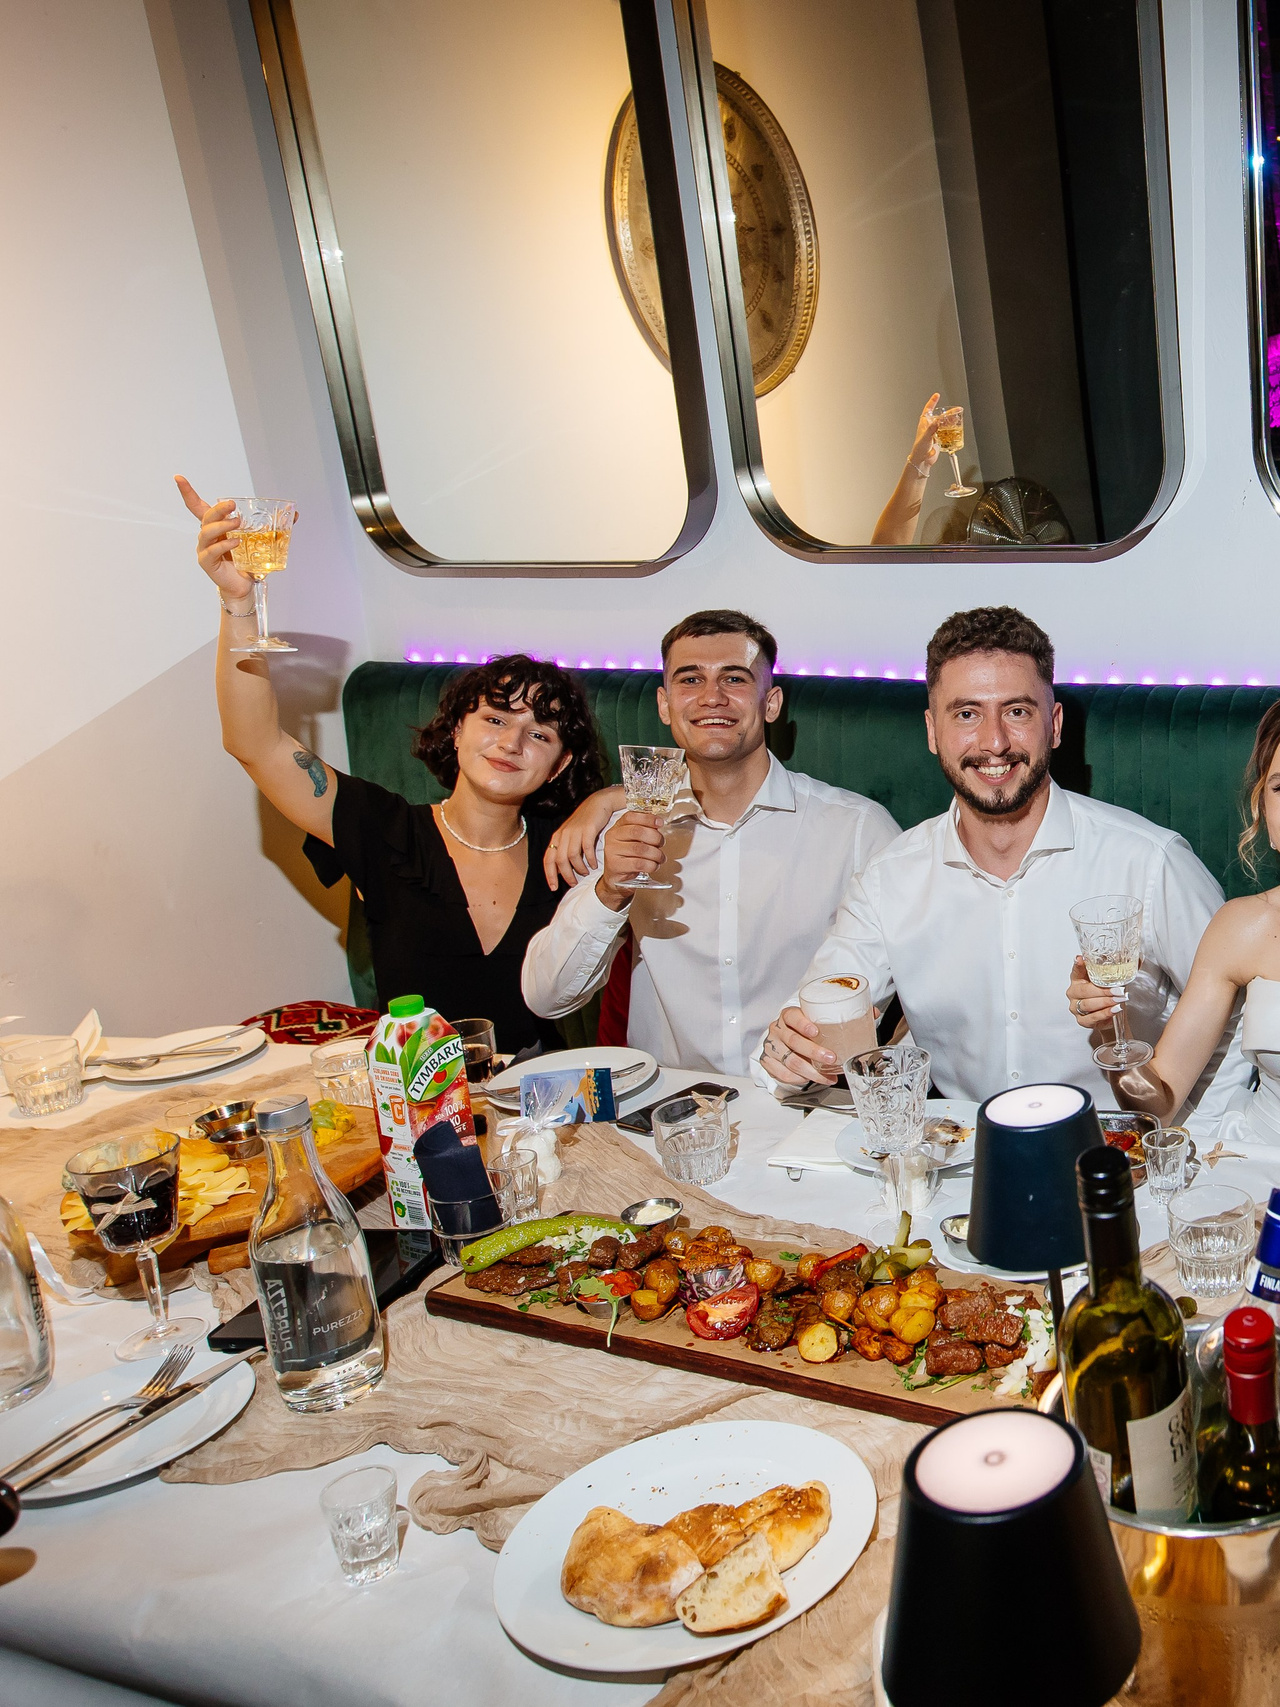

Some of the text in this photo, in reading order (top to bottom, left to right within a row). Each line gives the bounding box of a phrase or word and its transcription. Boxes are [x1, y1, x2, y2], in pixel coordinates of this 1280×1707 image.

[410, 1040, 463, 1094] TYMBARK
[444, 1100, 465, 1116] 100%
[312, 1309, 365, 1337] PUREZZA
